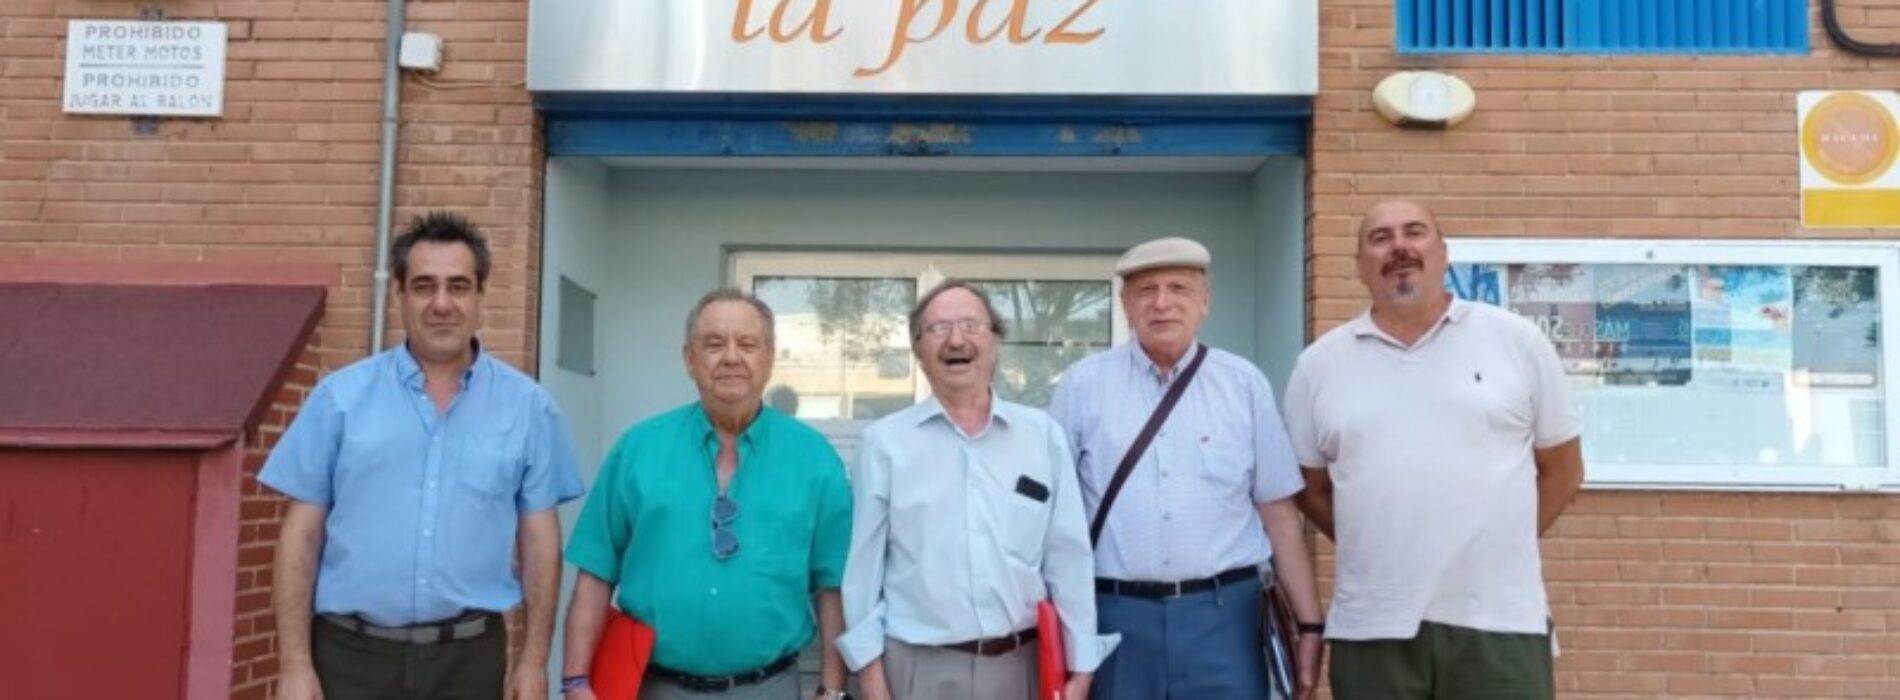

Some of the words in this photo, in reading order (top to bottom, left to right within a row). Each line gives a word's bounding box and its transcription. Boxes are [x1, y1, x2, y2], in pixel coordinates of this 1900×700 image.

[84, 25, 202, 40] PROHIBIDO
[852, 0, 1106, 77] paz
[82, 45, 136, 60] METER
[144, 45, 203, 60] MOTOS
[82, 73, 200, 88] PROHIBIDO
[70, 94, 121, 108] JUGAR
[130, 94, 148, 108] AL
